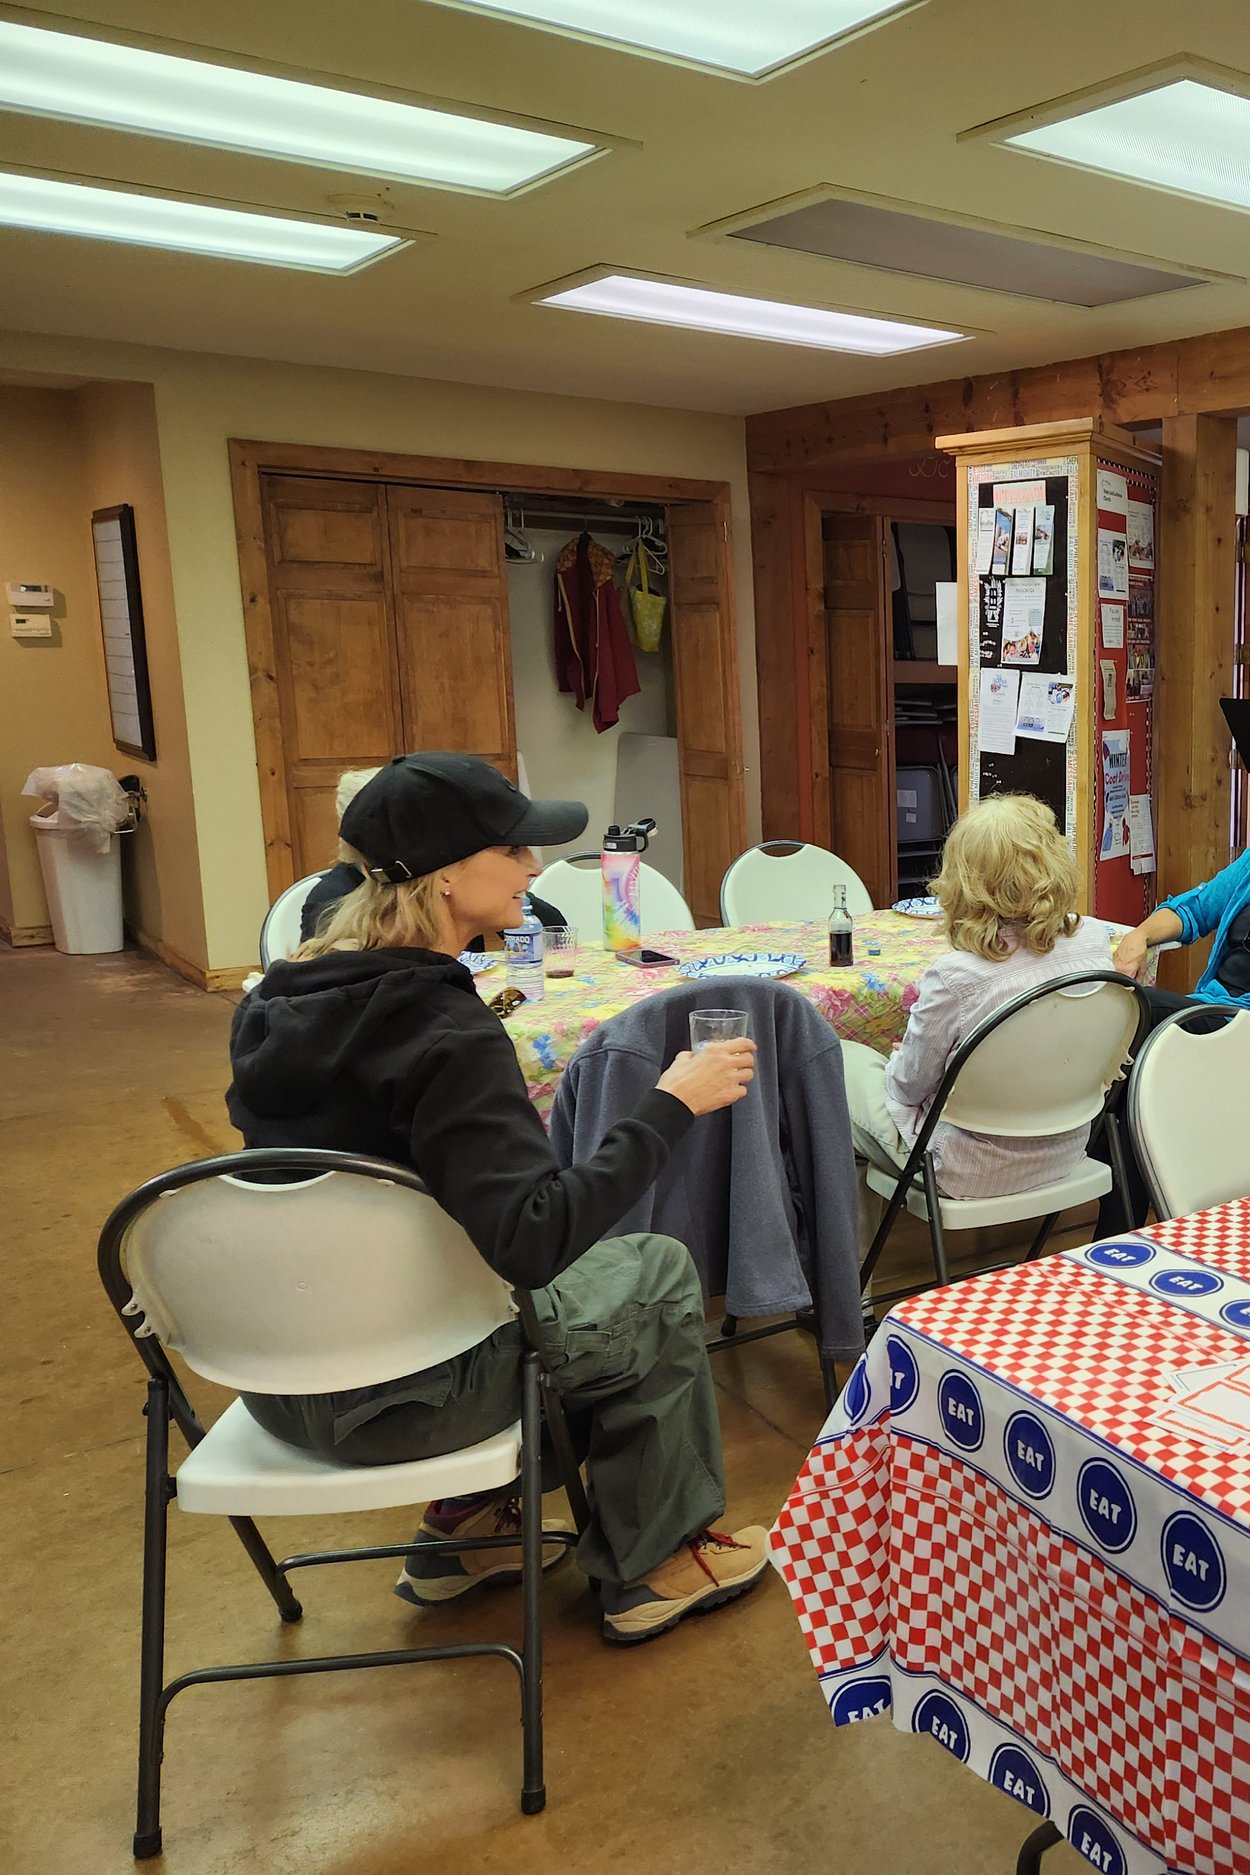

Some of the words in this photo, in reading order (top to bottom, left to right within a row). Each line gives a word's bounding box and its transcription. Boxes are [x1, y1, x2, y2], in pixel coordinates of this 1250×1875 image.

[1103, 1247, 1137, 1262] EAT
[1168, 1275, 1204, 1291] EAT
[947, 1397, 975, 1427] EAT
[1016, 1439, 1045, 1472] EAT
[1088, 1488, 1122, 1525] EAT
[1172, 1544, 1210, 1582] EAT
[847, 1698, 885, 1724] EAT
[931, 1715, 958, 1750] EAT
[1003, 1769, 1035, 1805] EAT
[1080, 1831, 1113, 1873] EAT
